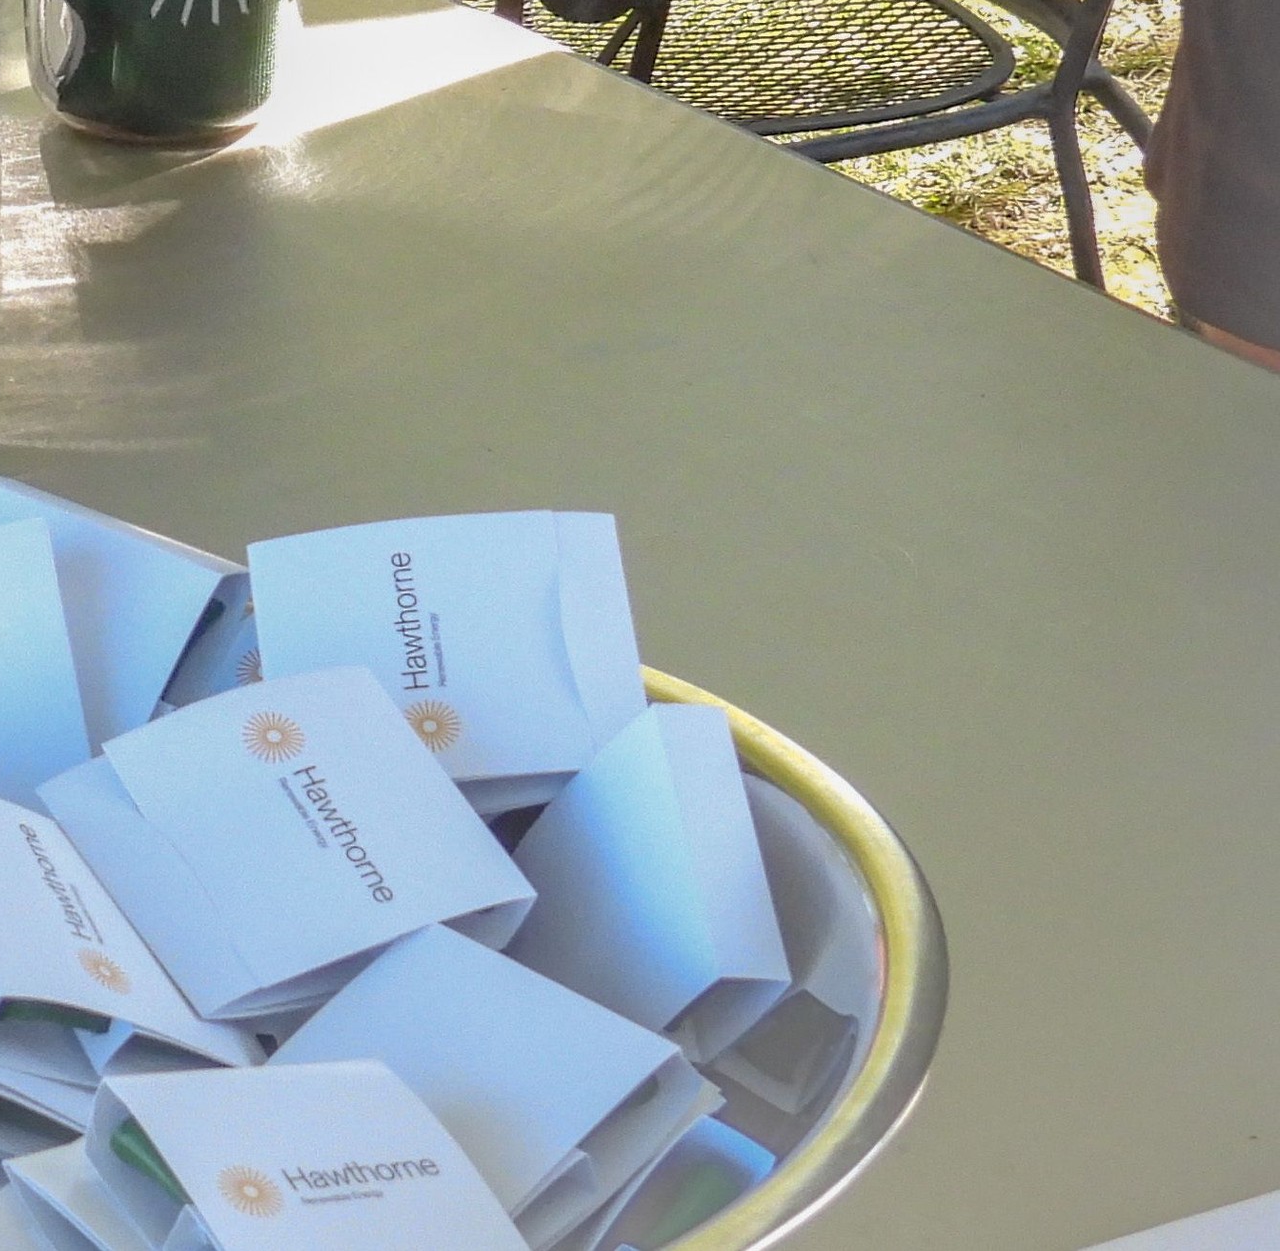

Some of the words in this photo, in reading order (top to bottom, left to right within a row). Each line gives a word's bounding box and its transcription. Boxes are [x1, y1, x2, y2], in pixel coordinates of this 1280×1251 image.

[390, 551, 430, 691] Hawthorne
[19, 823, 92, 942] Hawthorne
[293, 765, 394, 904] Hawthorne
[280, 1157, 441, 1192] Hawthorne
